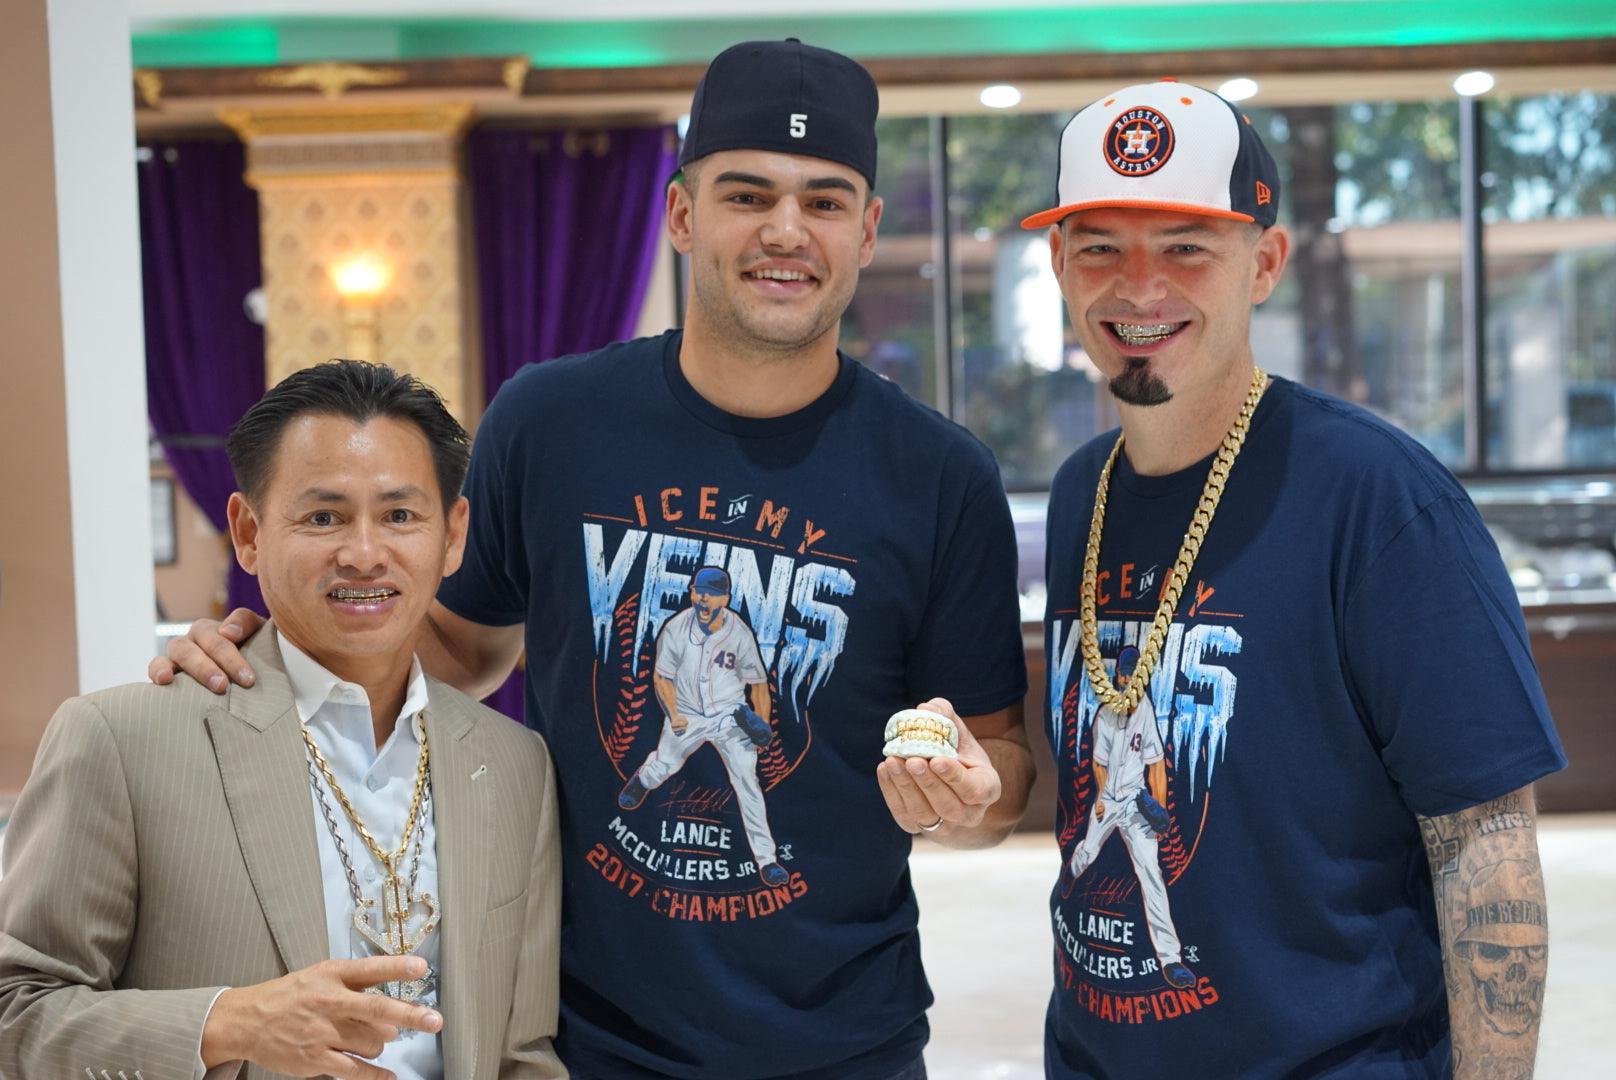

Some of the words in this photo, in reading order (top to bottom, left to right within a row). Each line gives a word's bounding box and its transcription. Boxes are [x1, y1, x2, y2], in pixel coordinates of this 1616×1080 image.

[790, 113, 808, 138] 5
[1114, 110, 1165, 130] HOUSTON
[1123, 130, 1151, 154] H
[1113, 157, 1159, 172] ASTROS
[634, 486, 720, 528] ICE
[727, 500, 748, 518] IN
[754, 499, 828, 555] MY
[1080, 562, 1136, 606] CE
[1139, 571, 1155, 592] IN
[713, 650, 736, 670] 43
[1129, 733, 1143, 752] 43
[607, 815, 731, 881] MCCULLERS
[735, 860, 757, 879] JR
[660, 820, 733, 850] LANCE
[585, 842, 645, 898] 2017
[650, 871, 809, 922] CHAMPIONS
[1078, 911, 1136, 946] LANCE
[1138, 957, 1159, 976] JR
[1077, 976, 1220, 1025] CHAMPIONS
